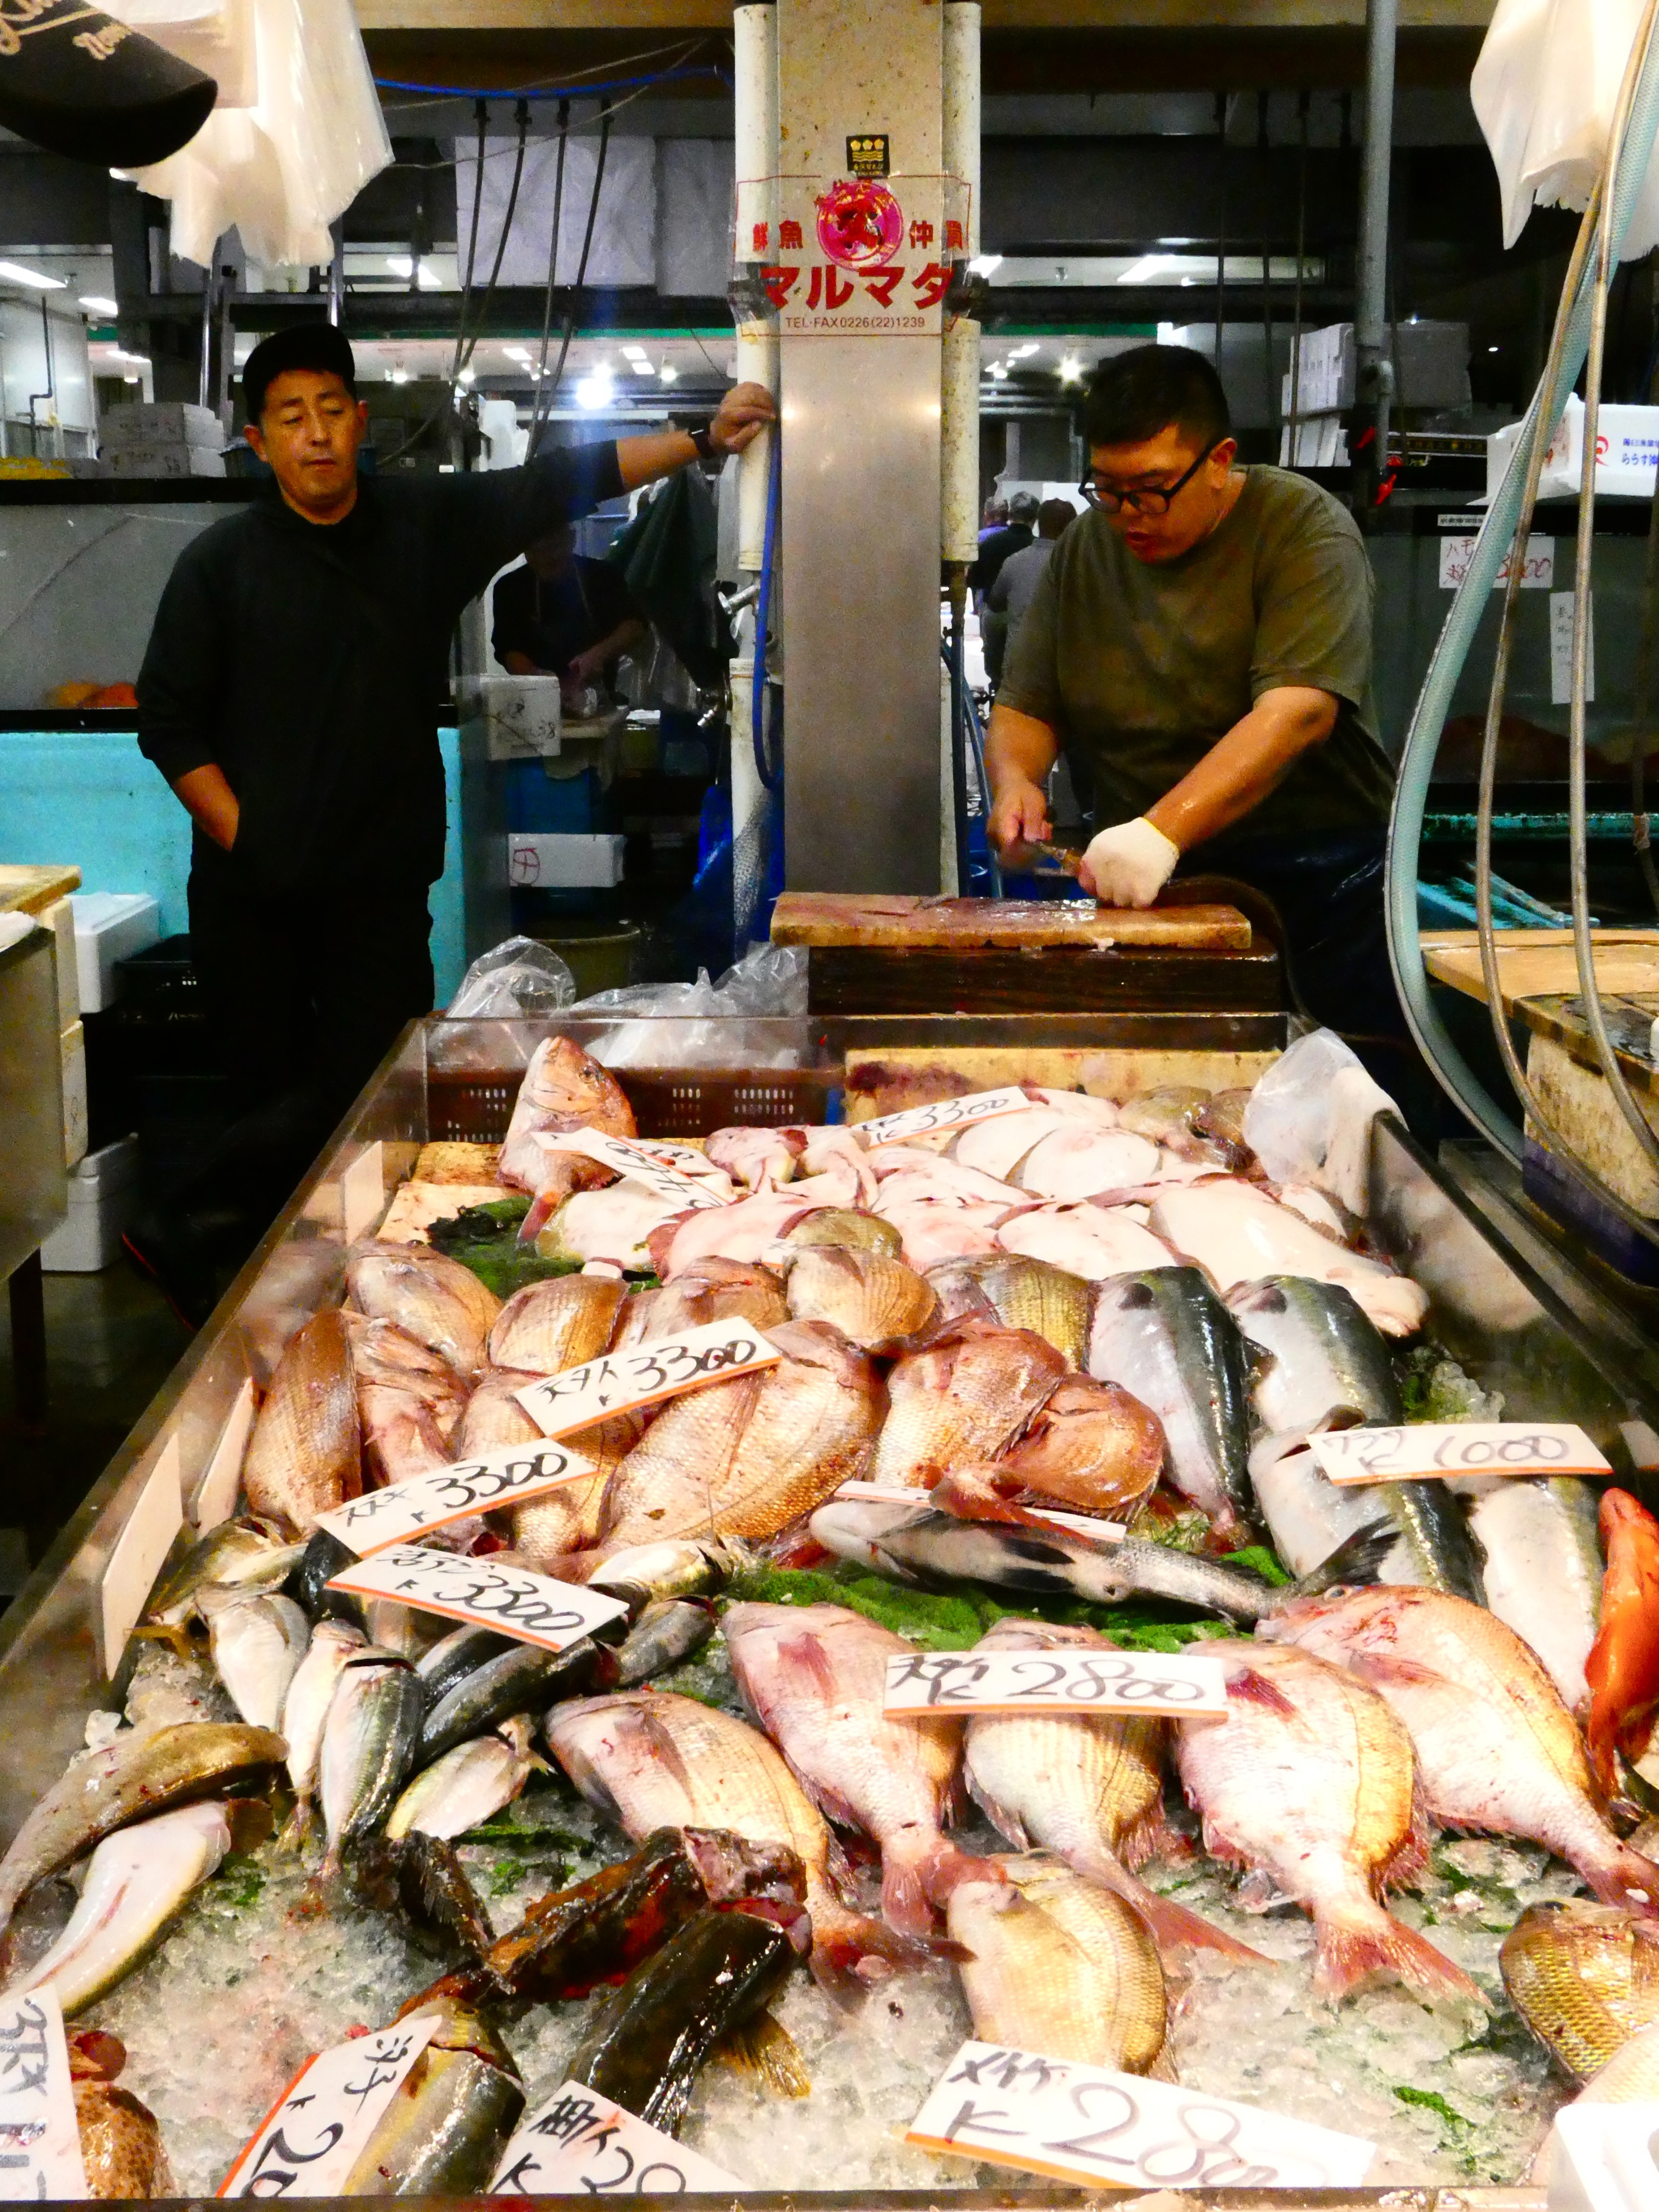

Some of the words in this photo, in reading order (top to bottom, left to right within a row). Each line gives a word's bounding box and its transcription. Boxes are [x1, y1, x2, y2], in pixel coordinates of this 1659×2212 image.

[760, 262, 955, 310] マルマタ
[910, 1098, 1010, 1132] 3300
[627, 1339, 757, 1392] 3300
[1357, 1453, 1405, 1475] K
[1433, 1435, 1570, 1467] 1000
[425, 1452, 568, 1509] 3300
[433, 1574, 586, 1630] 3300
[927, 1677, 980, 1705] K
[1006, 1659, 1207, 1701] 2800
[945, 2099, 1030, 2145] K
[490, 2151, 542, 2194] K
